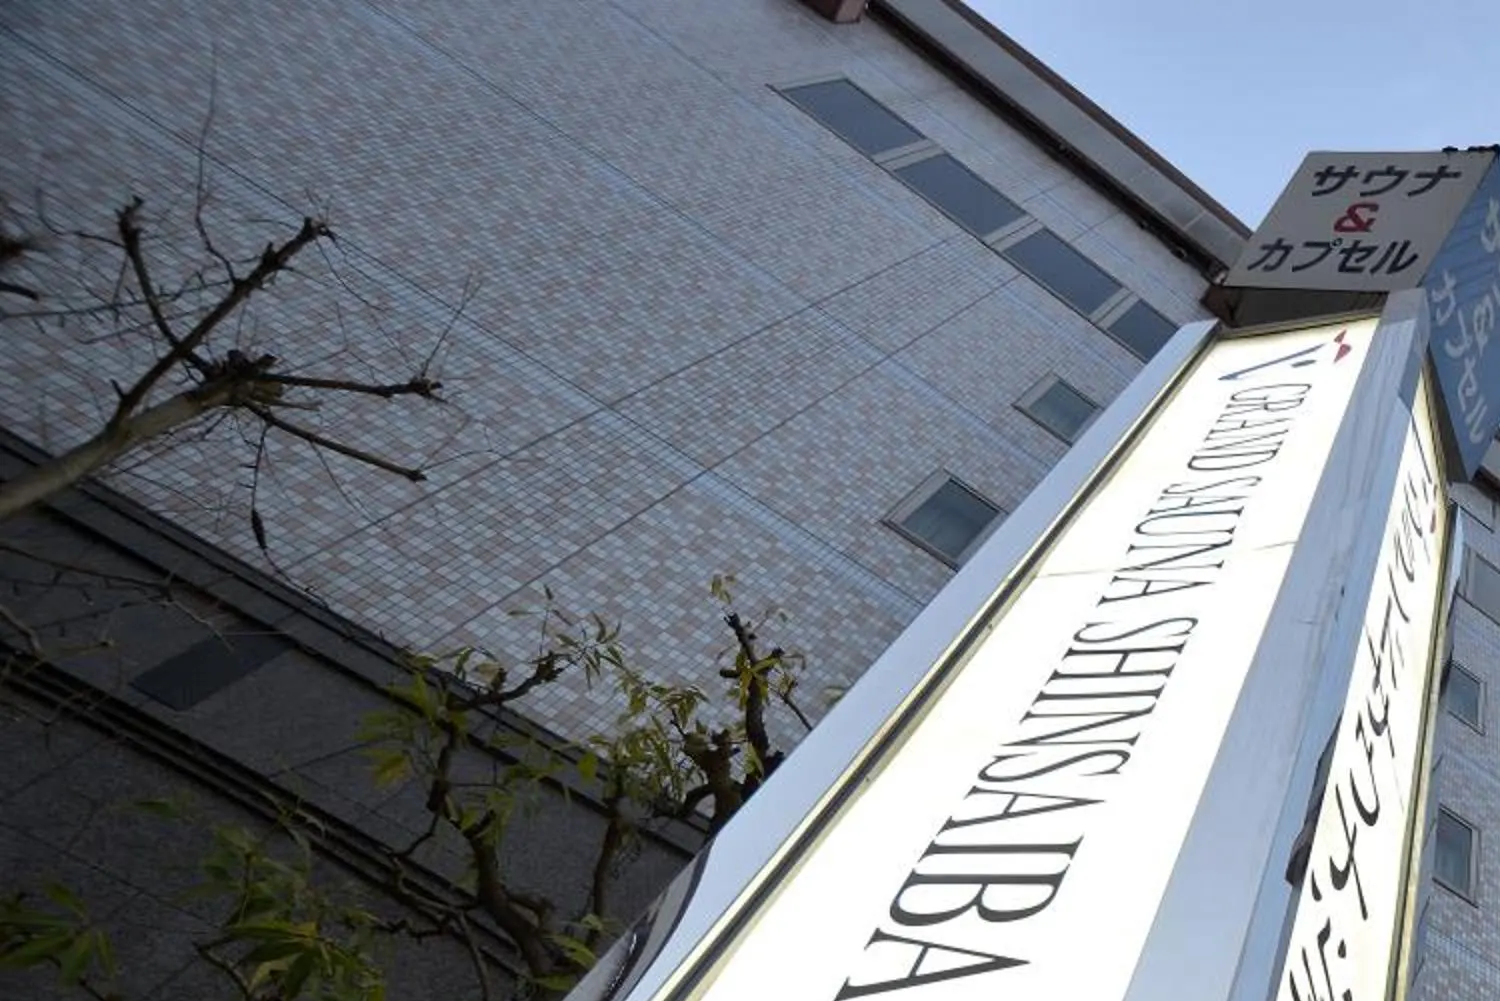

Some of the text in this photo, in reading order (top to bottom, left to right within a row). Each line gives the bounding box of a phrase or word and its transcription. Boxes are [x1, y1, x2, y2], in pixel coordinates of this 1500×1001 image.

[1311, 164, 1463, 197] サウナ
[1333, 202, 1380, 233] &
[1247, 237, 1420, 275] カプセル
[1187, 383, 1312, 471] GRAND
[1097, 473, 1262, 608] SAUNA
